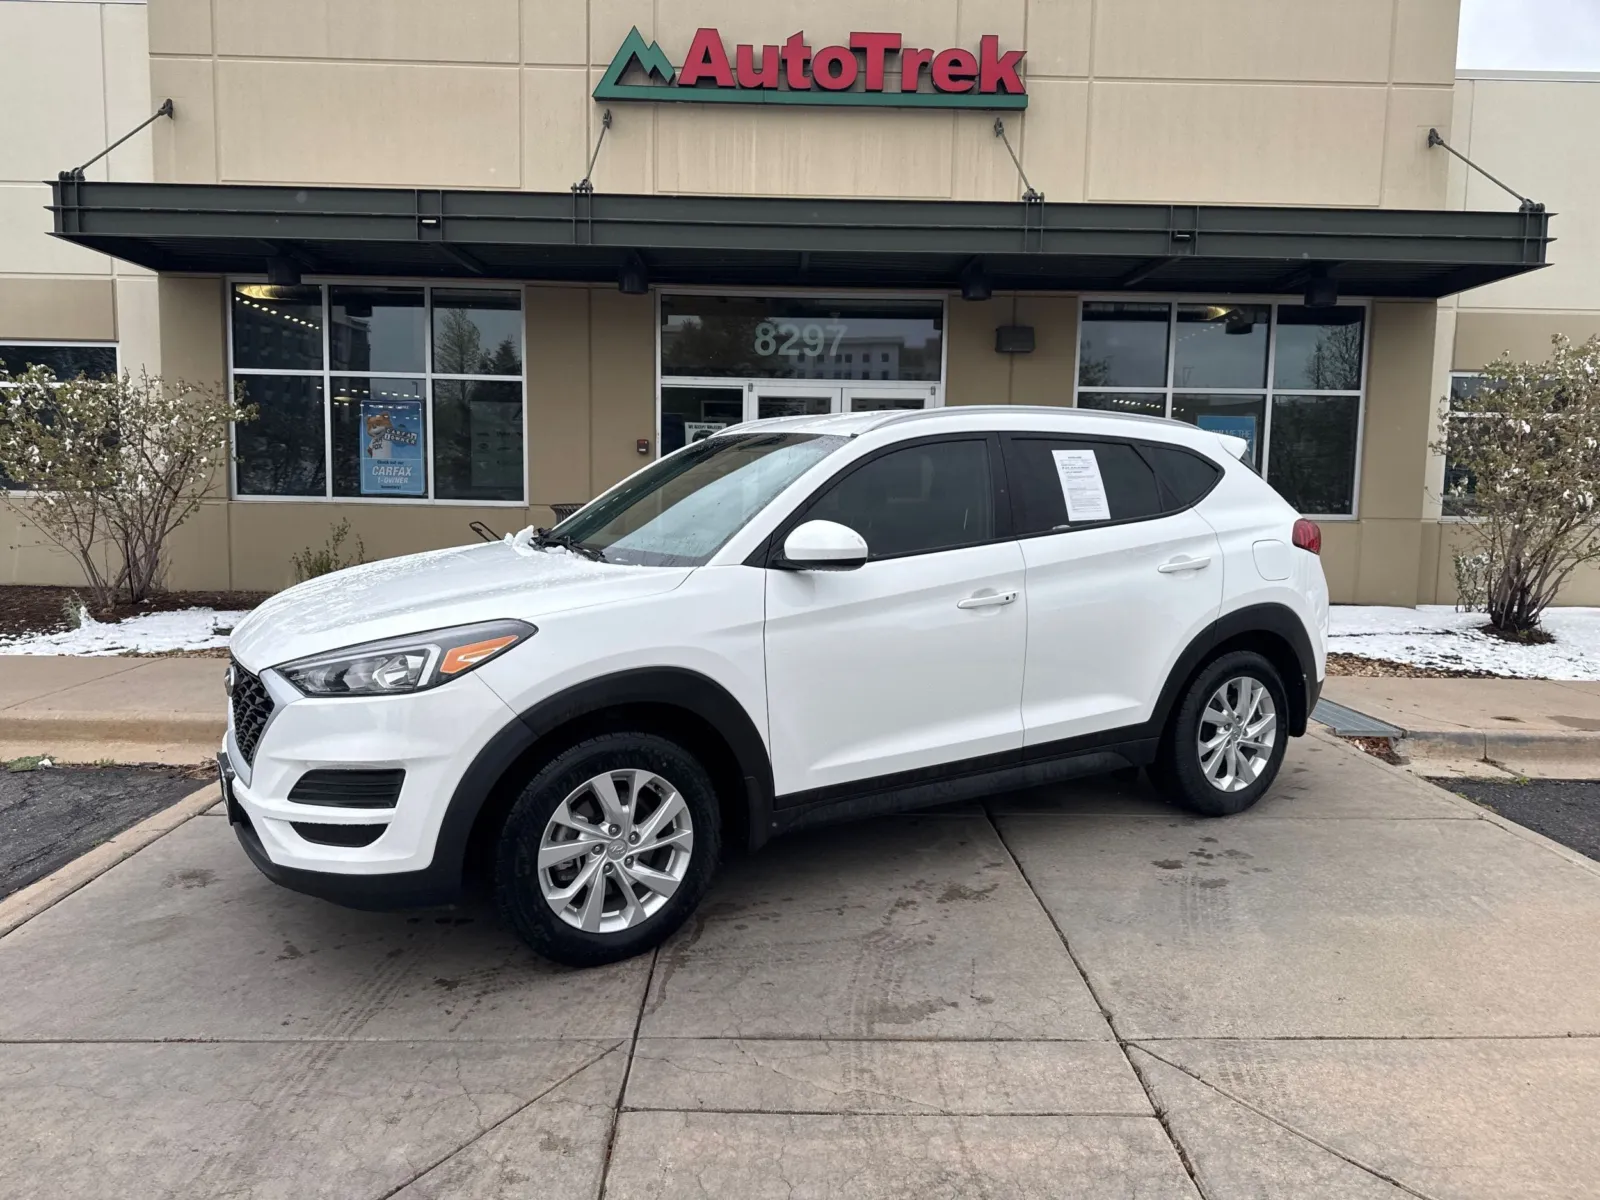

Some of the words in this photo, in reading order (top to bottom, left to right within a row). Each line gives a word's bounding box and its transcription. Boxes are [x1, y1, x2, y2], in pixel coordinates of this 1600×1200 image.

[677, 28, 1028, 94] AutoTrek
[754, 322, 848, 357] 8297
[1238, 430, 1252, 438] THE
[372, 466, 412, 476] CARFAX
